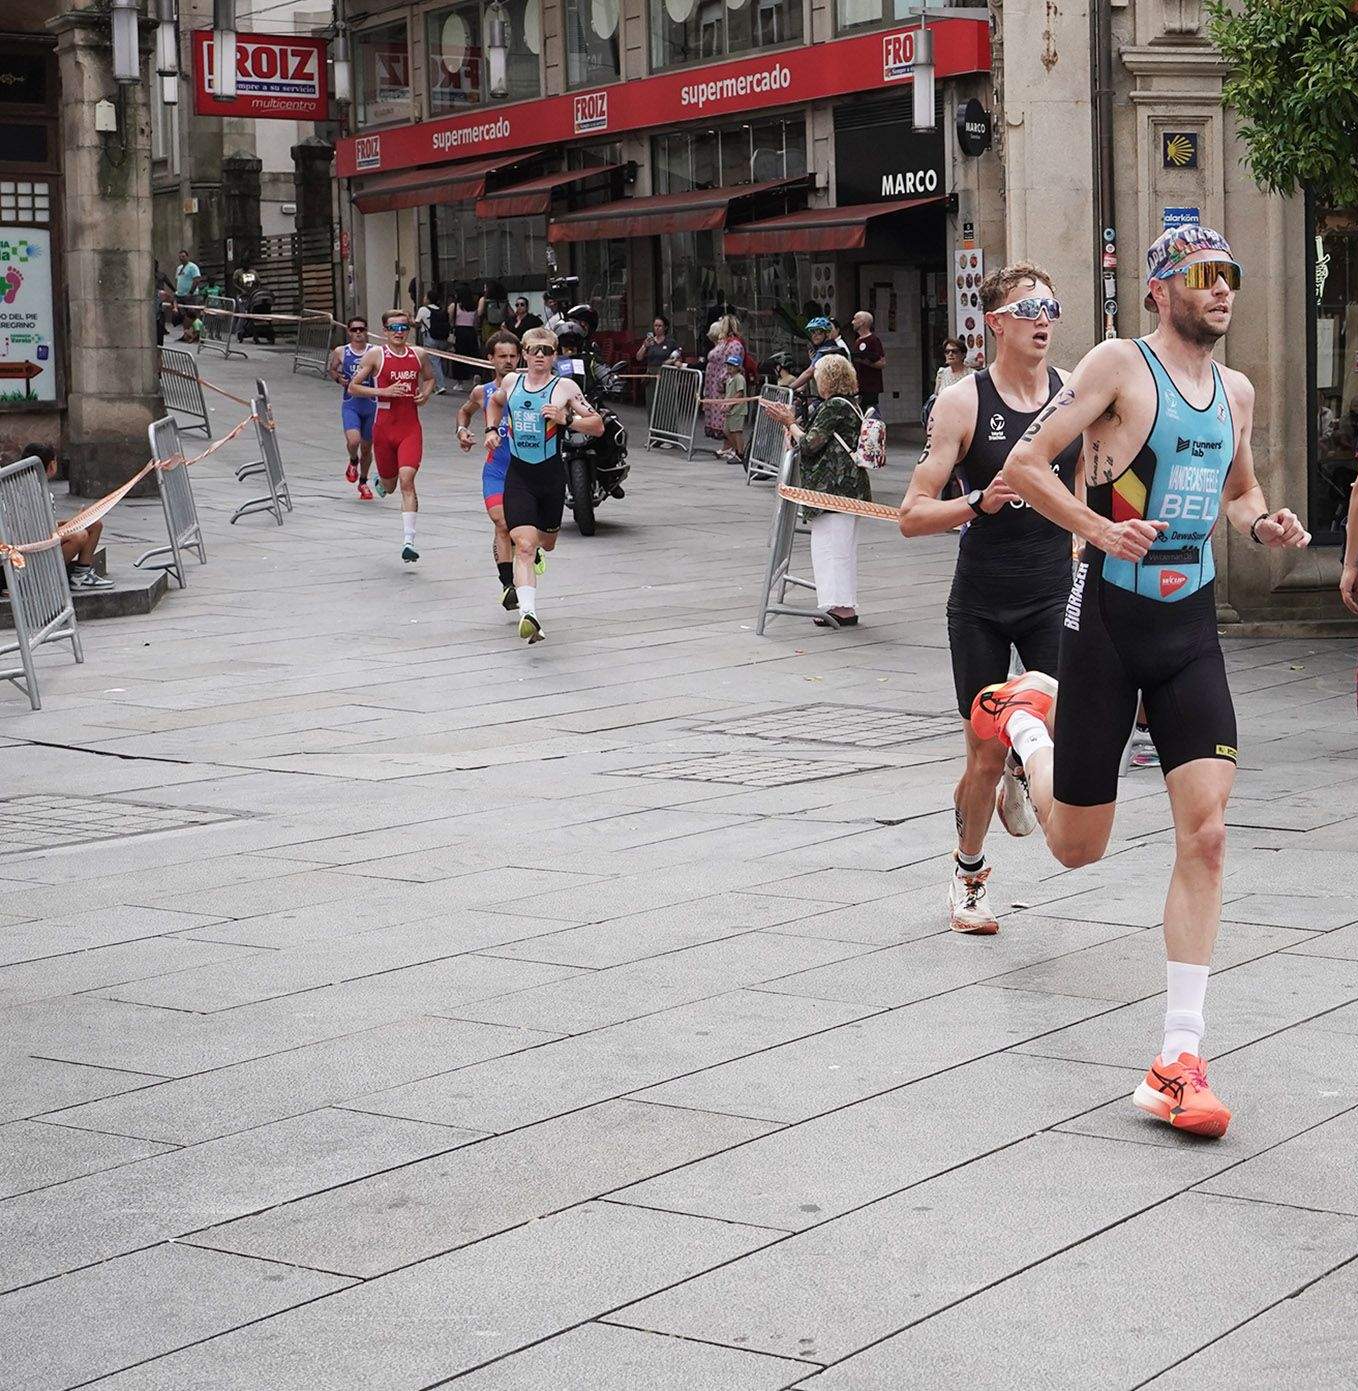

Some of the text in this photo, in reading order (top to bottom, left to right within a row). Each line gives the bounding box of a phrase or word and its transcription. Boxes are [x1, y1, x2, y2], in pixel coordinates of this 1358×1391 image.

[207, 44, 315, 81] ROIZ
[681, 64, 790, 107] supermercado
[251, 98, 317, 111] multicentro
[576, 94, 606, 122] FROIZ
[433, 117, 510, 151] supermercado
[966, 122, 986, 133] MARCO
[357, 137, 379, 160] FROIZ
[881, 169, 938, 196] MARCO
[515, 422, 540, 432] BEL
[1191, 448, 1205, 457] lab
[1159, 494, 1217, 520] BEL
